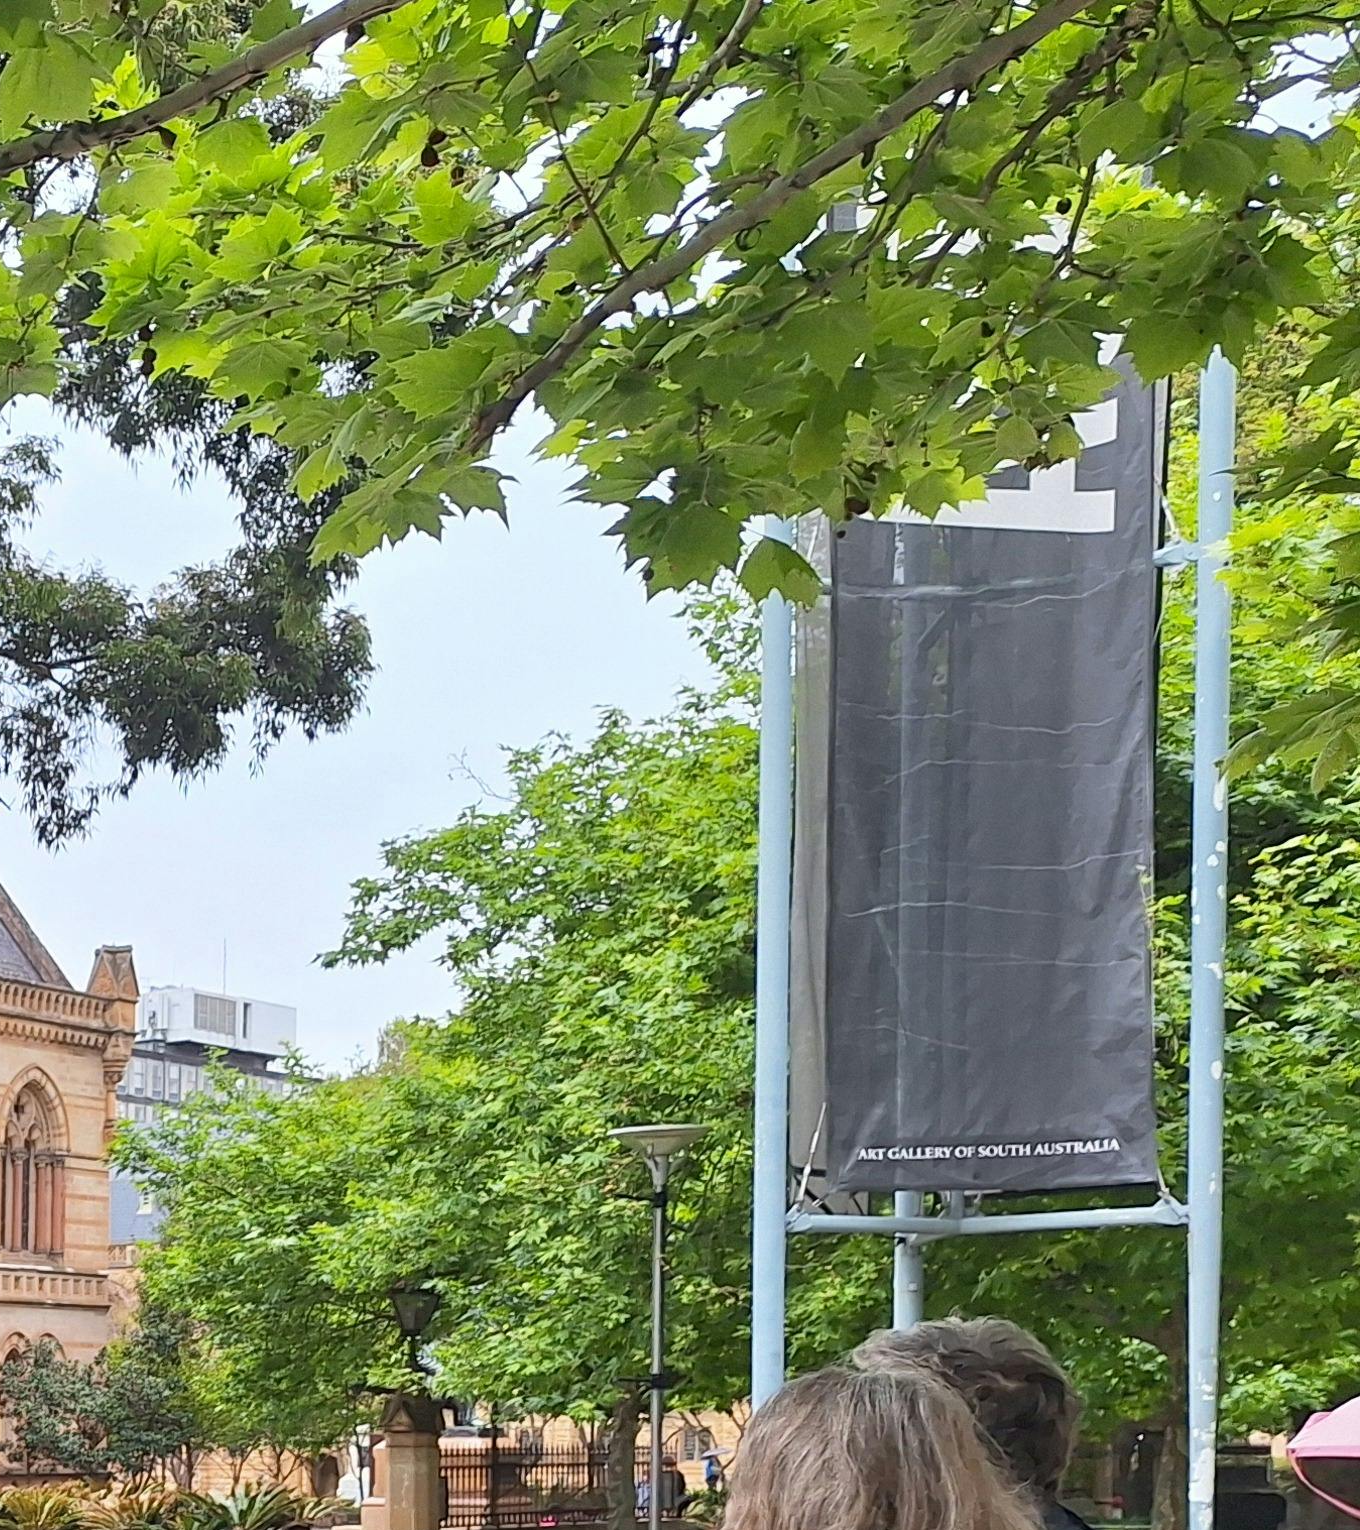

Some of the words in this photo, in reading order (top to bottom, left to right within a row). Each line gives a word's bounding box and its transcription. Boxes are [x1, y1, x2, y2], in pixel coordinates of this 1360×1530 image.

[858, 1147, 885, 1161] ART
[887, 1145, 952, 1160] GALLERY
[954, 1146, 977, 1159] OF
[978, 1143, 1031, 1158] SOUTH
[1033, 1138, 1121, 1156] AUSTRALIA
